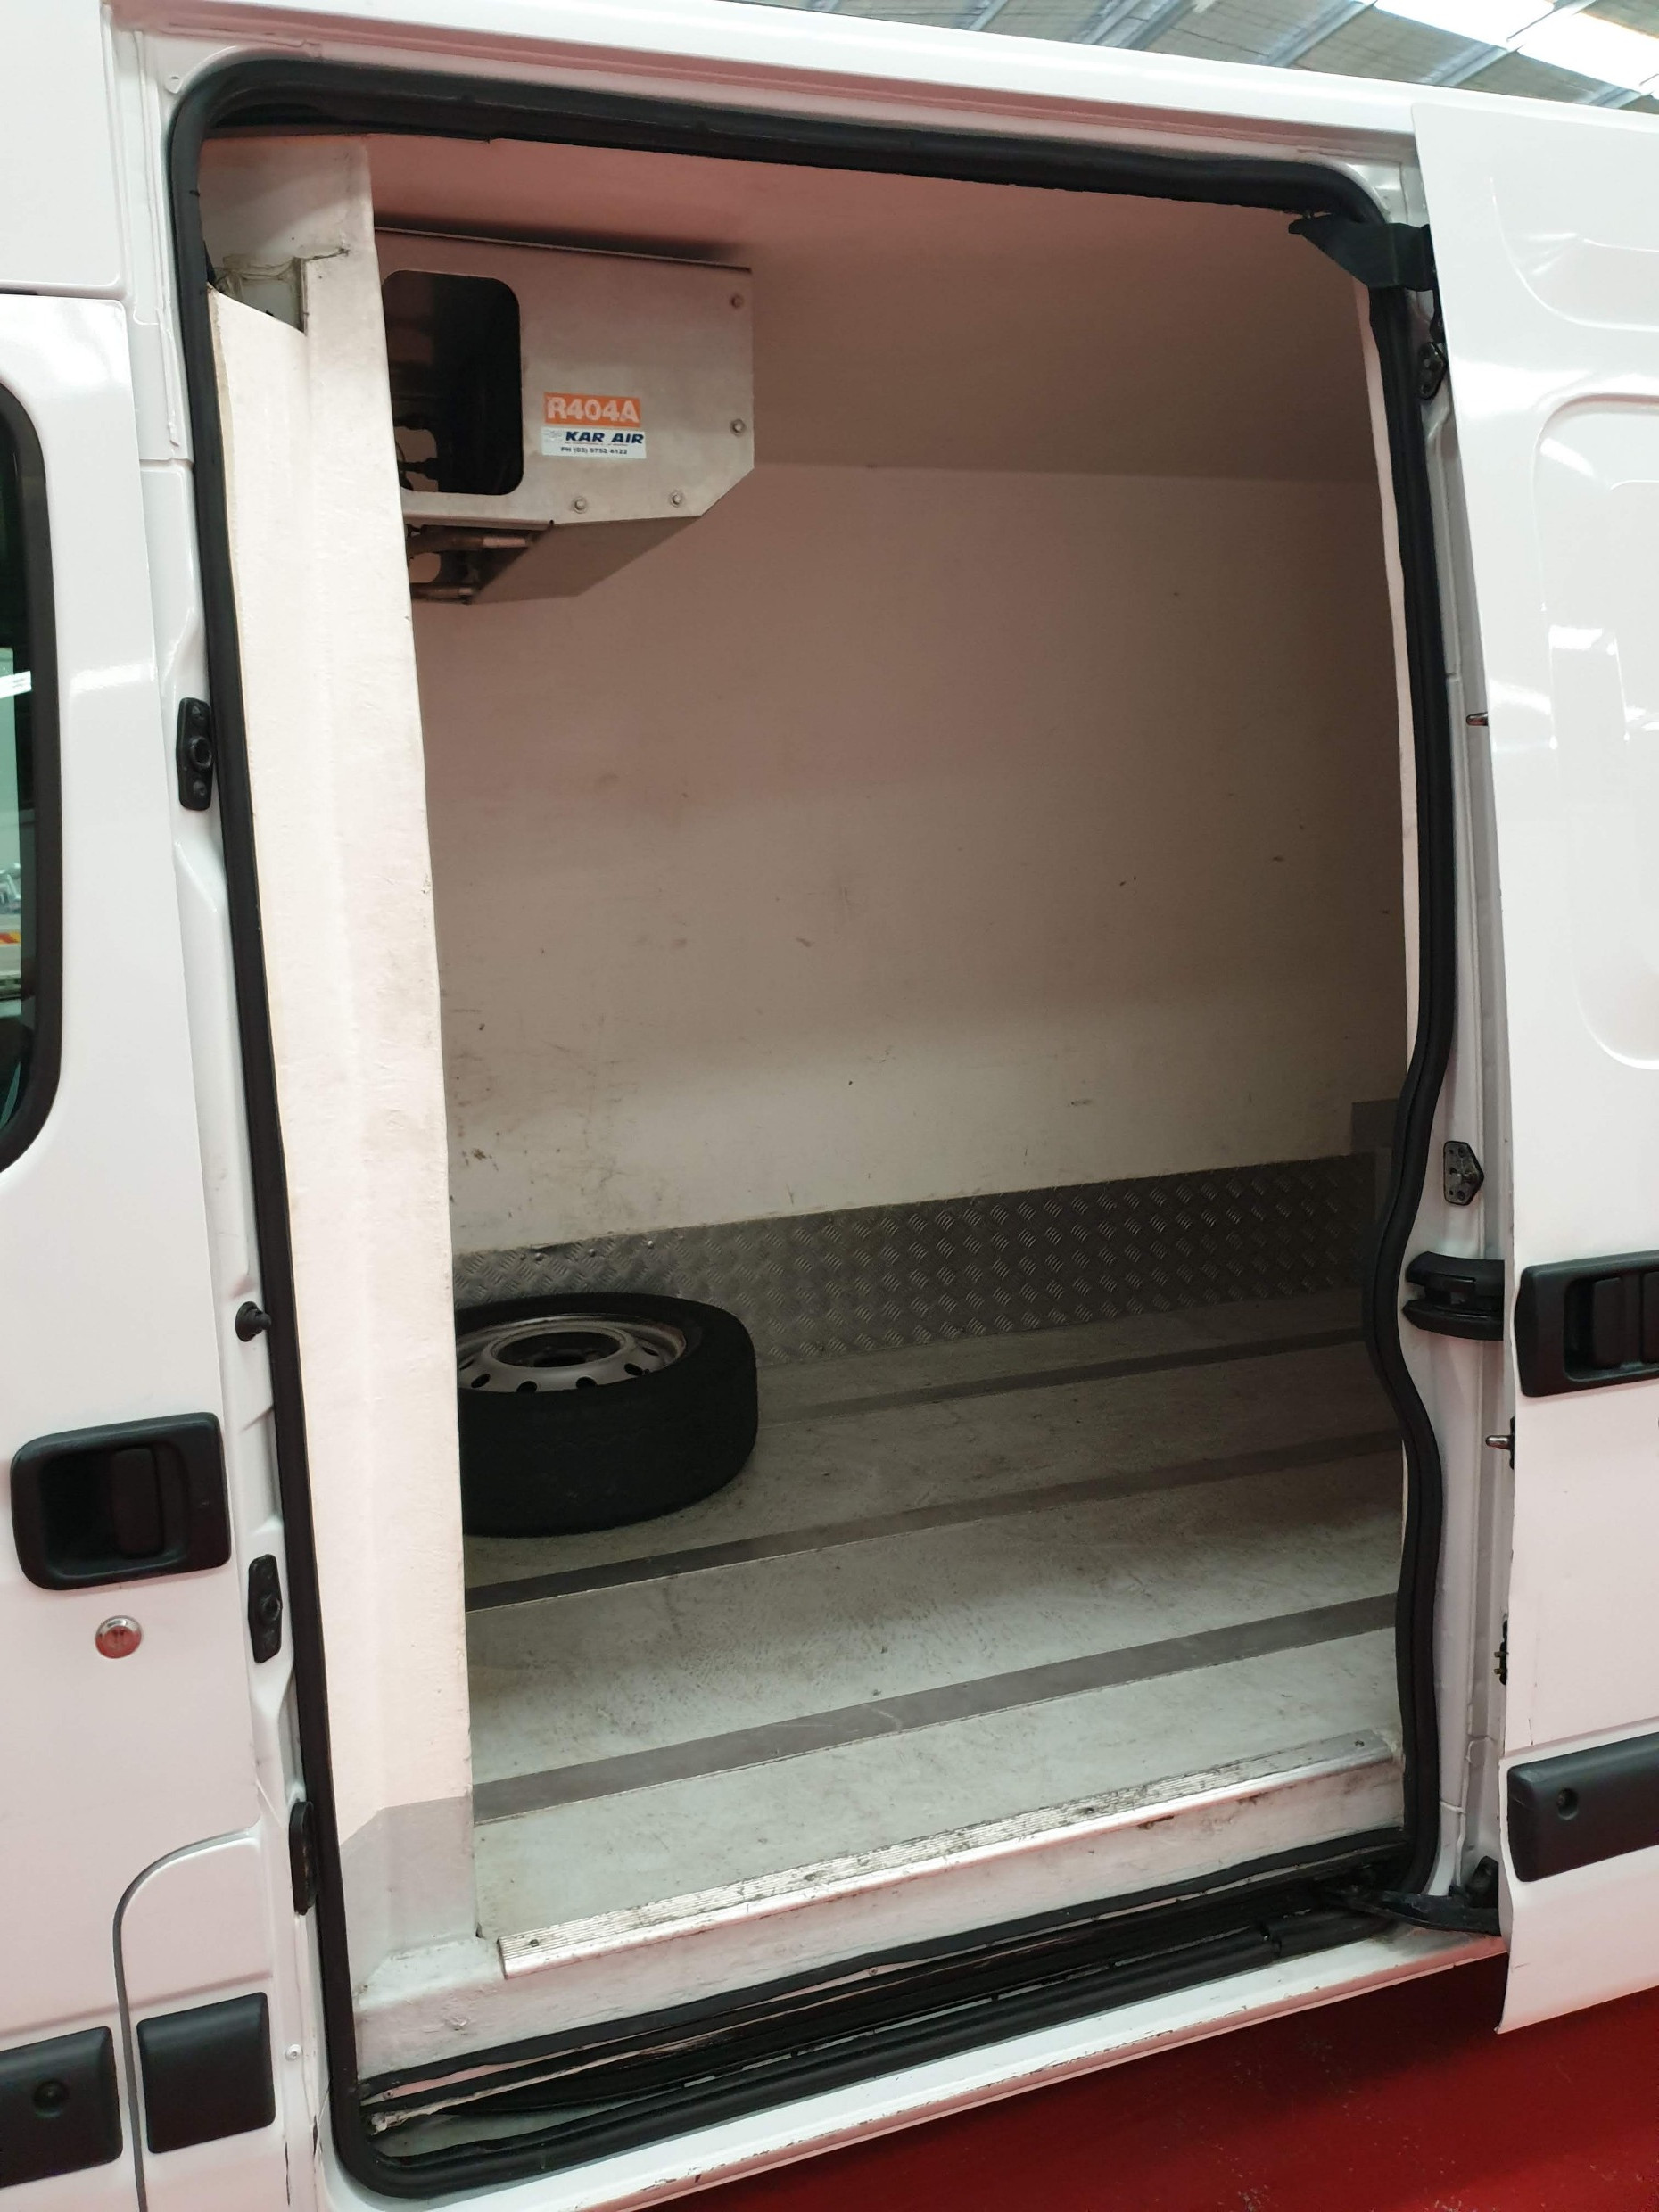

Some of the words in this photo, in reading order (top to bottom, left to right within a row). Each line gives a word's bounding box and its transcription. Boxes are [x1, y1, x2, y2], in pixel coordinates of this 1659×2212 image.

[546, 396, 640, 423] R404A
[565, 431, 606, 442] KAR
[611, 433, 645, 444] AIR
